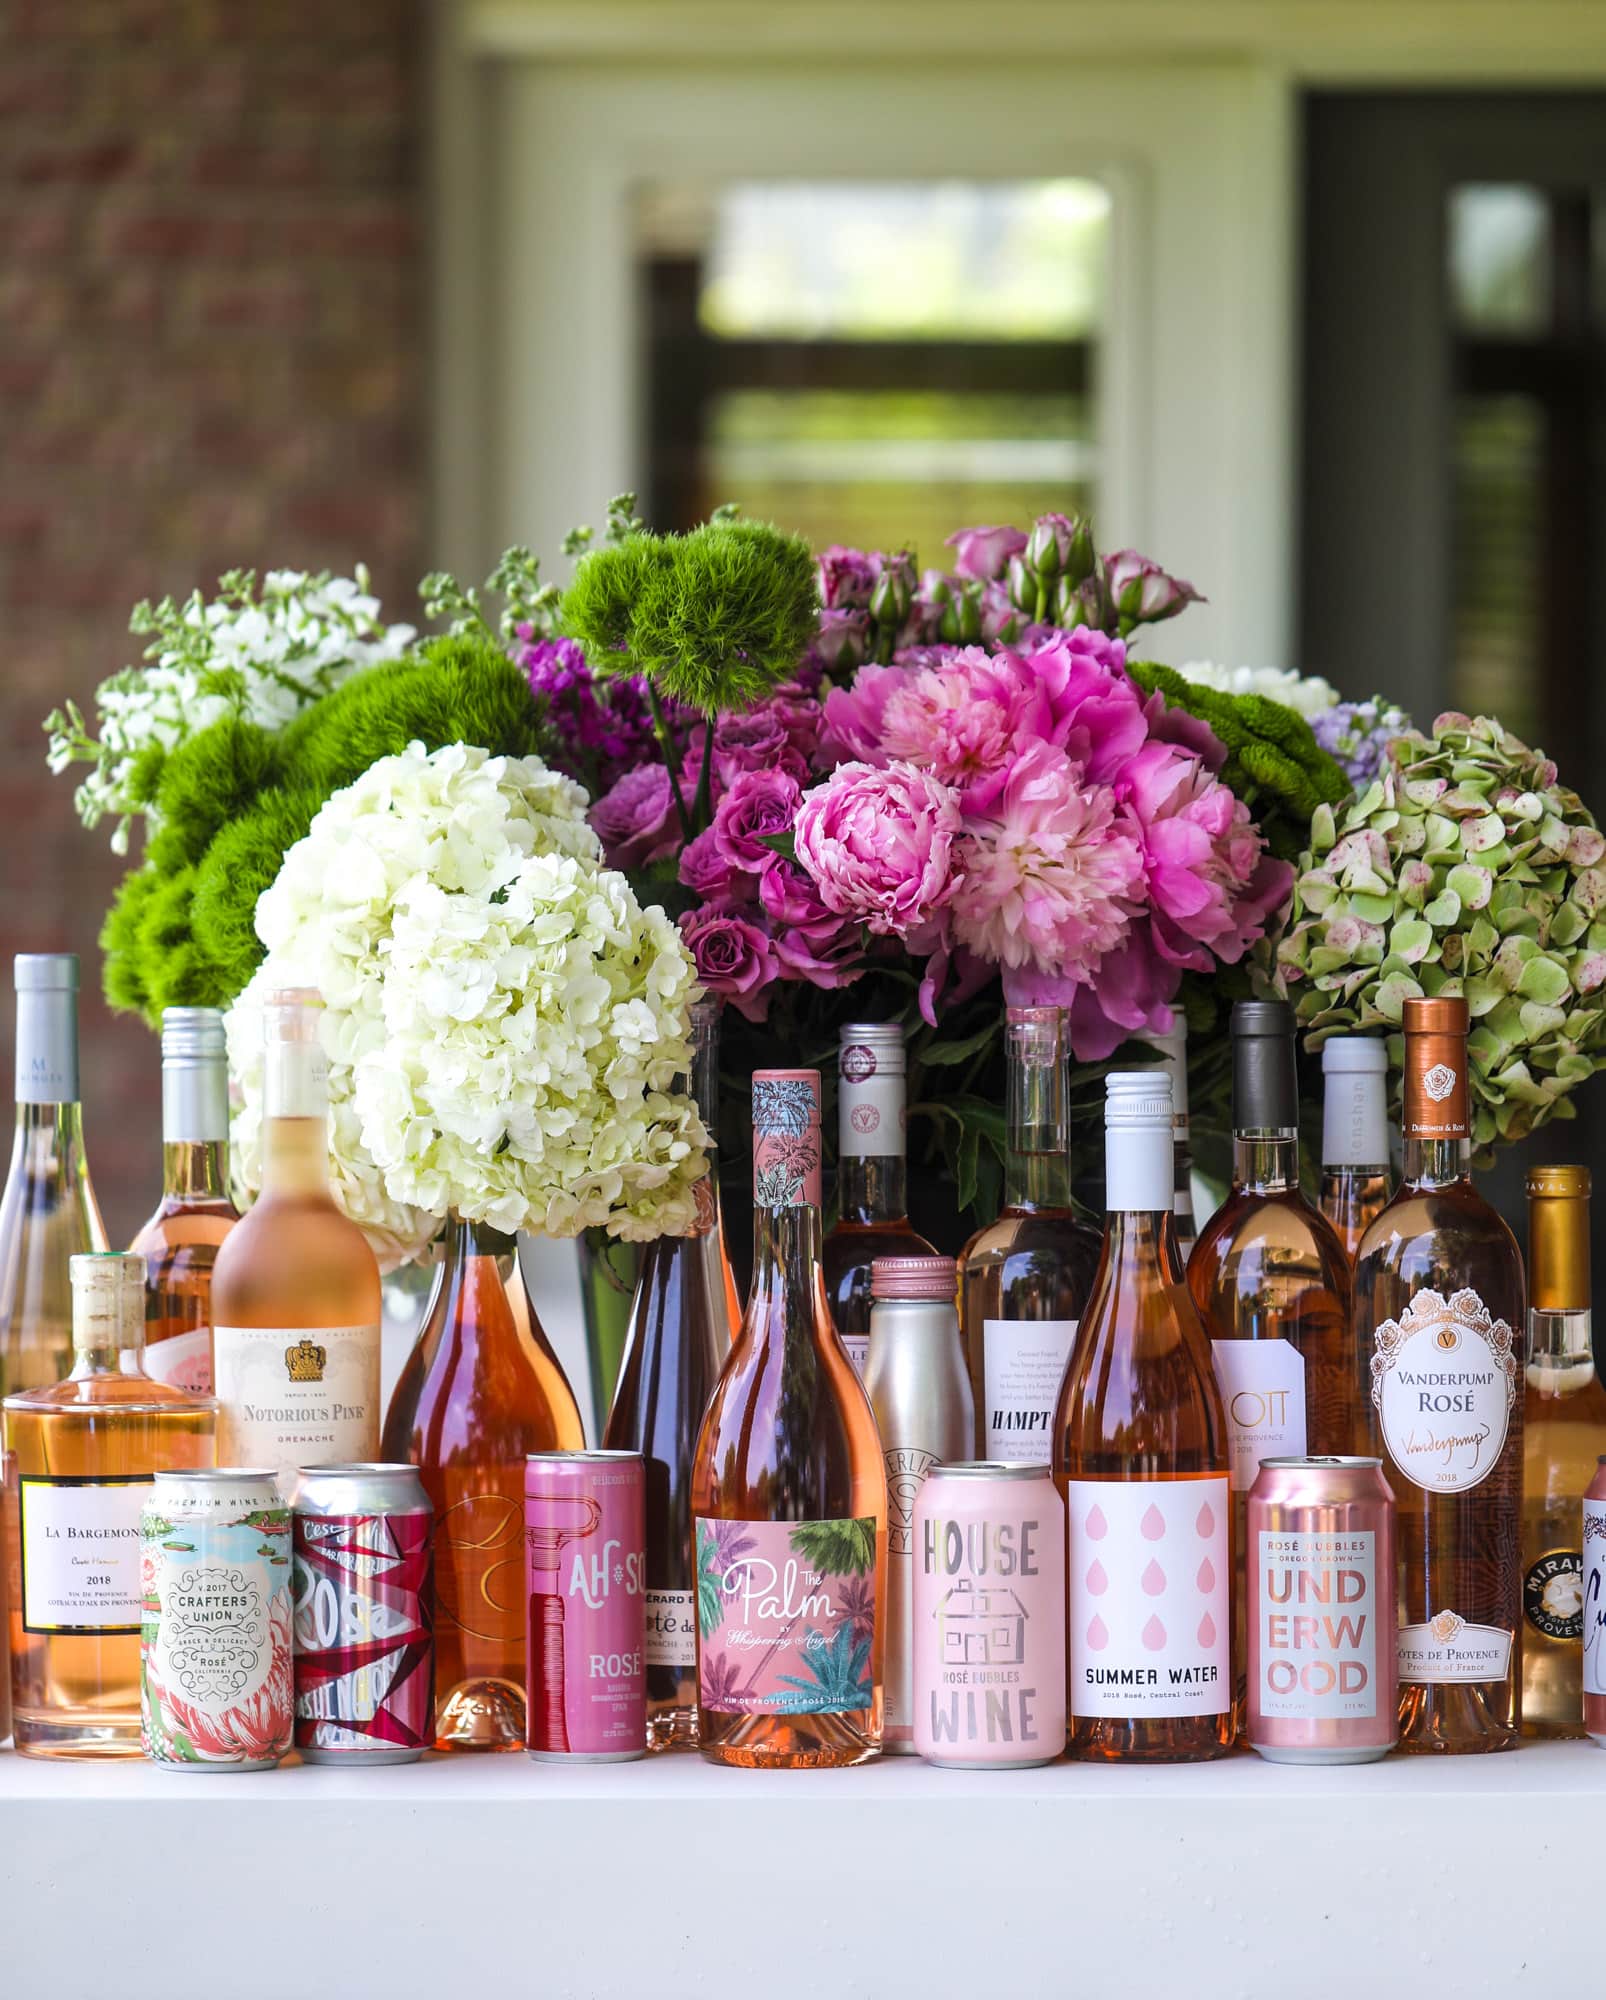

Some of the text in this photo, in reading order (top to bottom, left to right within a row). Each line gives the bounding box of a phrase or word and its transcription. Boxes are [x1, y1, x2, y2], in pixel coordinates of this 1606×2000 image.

[1398, 1372, 1495, 1385] VANDERPUMP
[1418, 1390, 1476, 1412] ROSÉ
[243, 1403, 365, 1422] NOTORIOUS PINK
[277, 1435, 335, 1443] GRENACHE
[1435, 1472, 1458, 1482] 2018
[45, 1526, 61, 1538] LA
[924, 1520, 1040, 1577] HOUSE
[86, 1575, 112, 1585] 2018
[799, 1570, 823, 1587] The
[1267, 1569, 1367, 1604] UND
[721, 1557, 837, 1626] Palm
[178, 1596, 248, 1607] CRAFTERS
[193, 1610, 233, 1622] UNION
[1268, 1614, 1368, 1650] ERW
[588, 1645, 641, 1678] ROSÉ
[1447, 1648, 1500, 1660] PROVENCE
[1085, 1665, 1218, 1685] SUMMER WATER
[1267, 1659, 1369, 1696] OOD
[930, 1687, 1039, 1743] WINE
